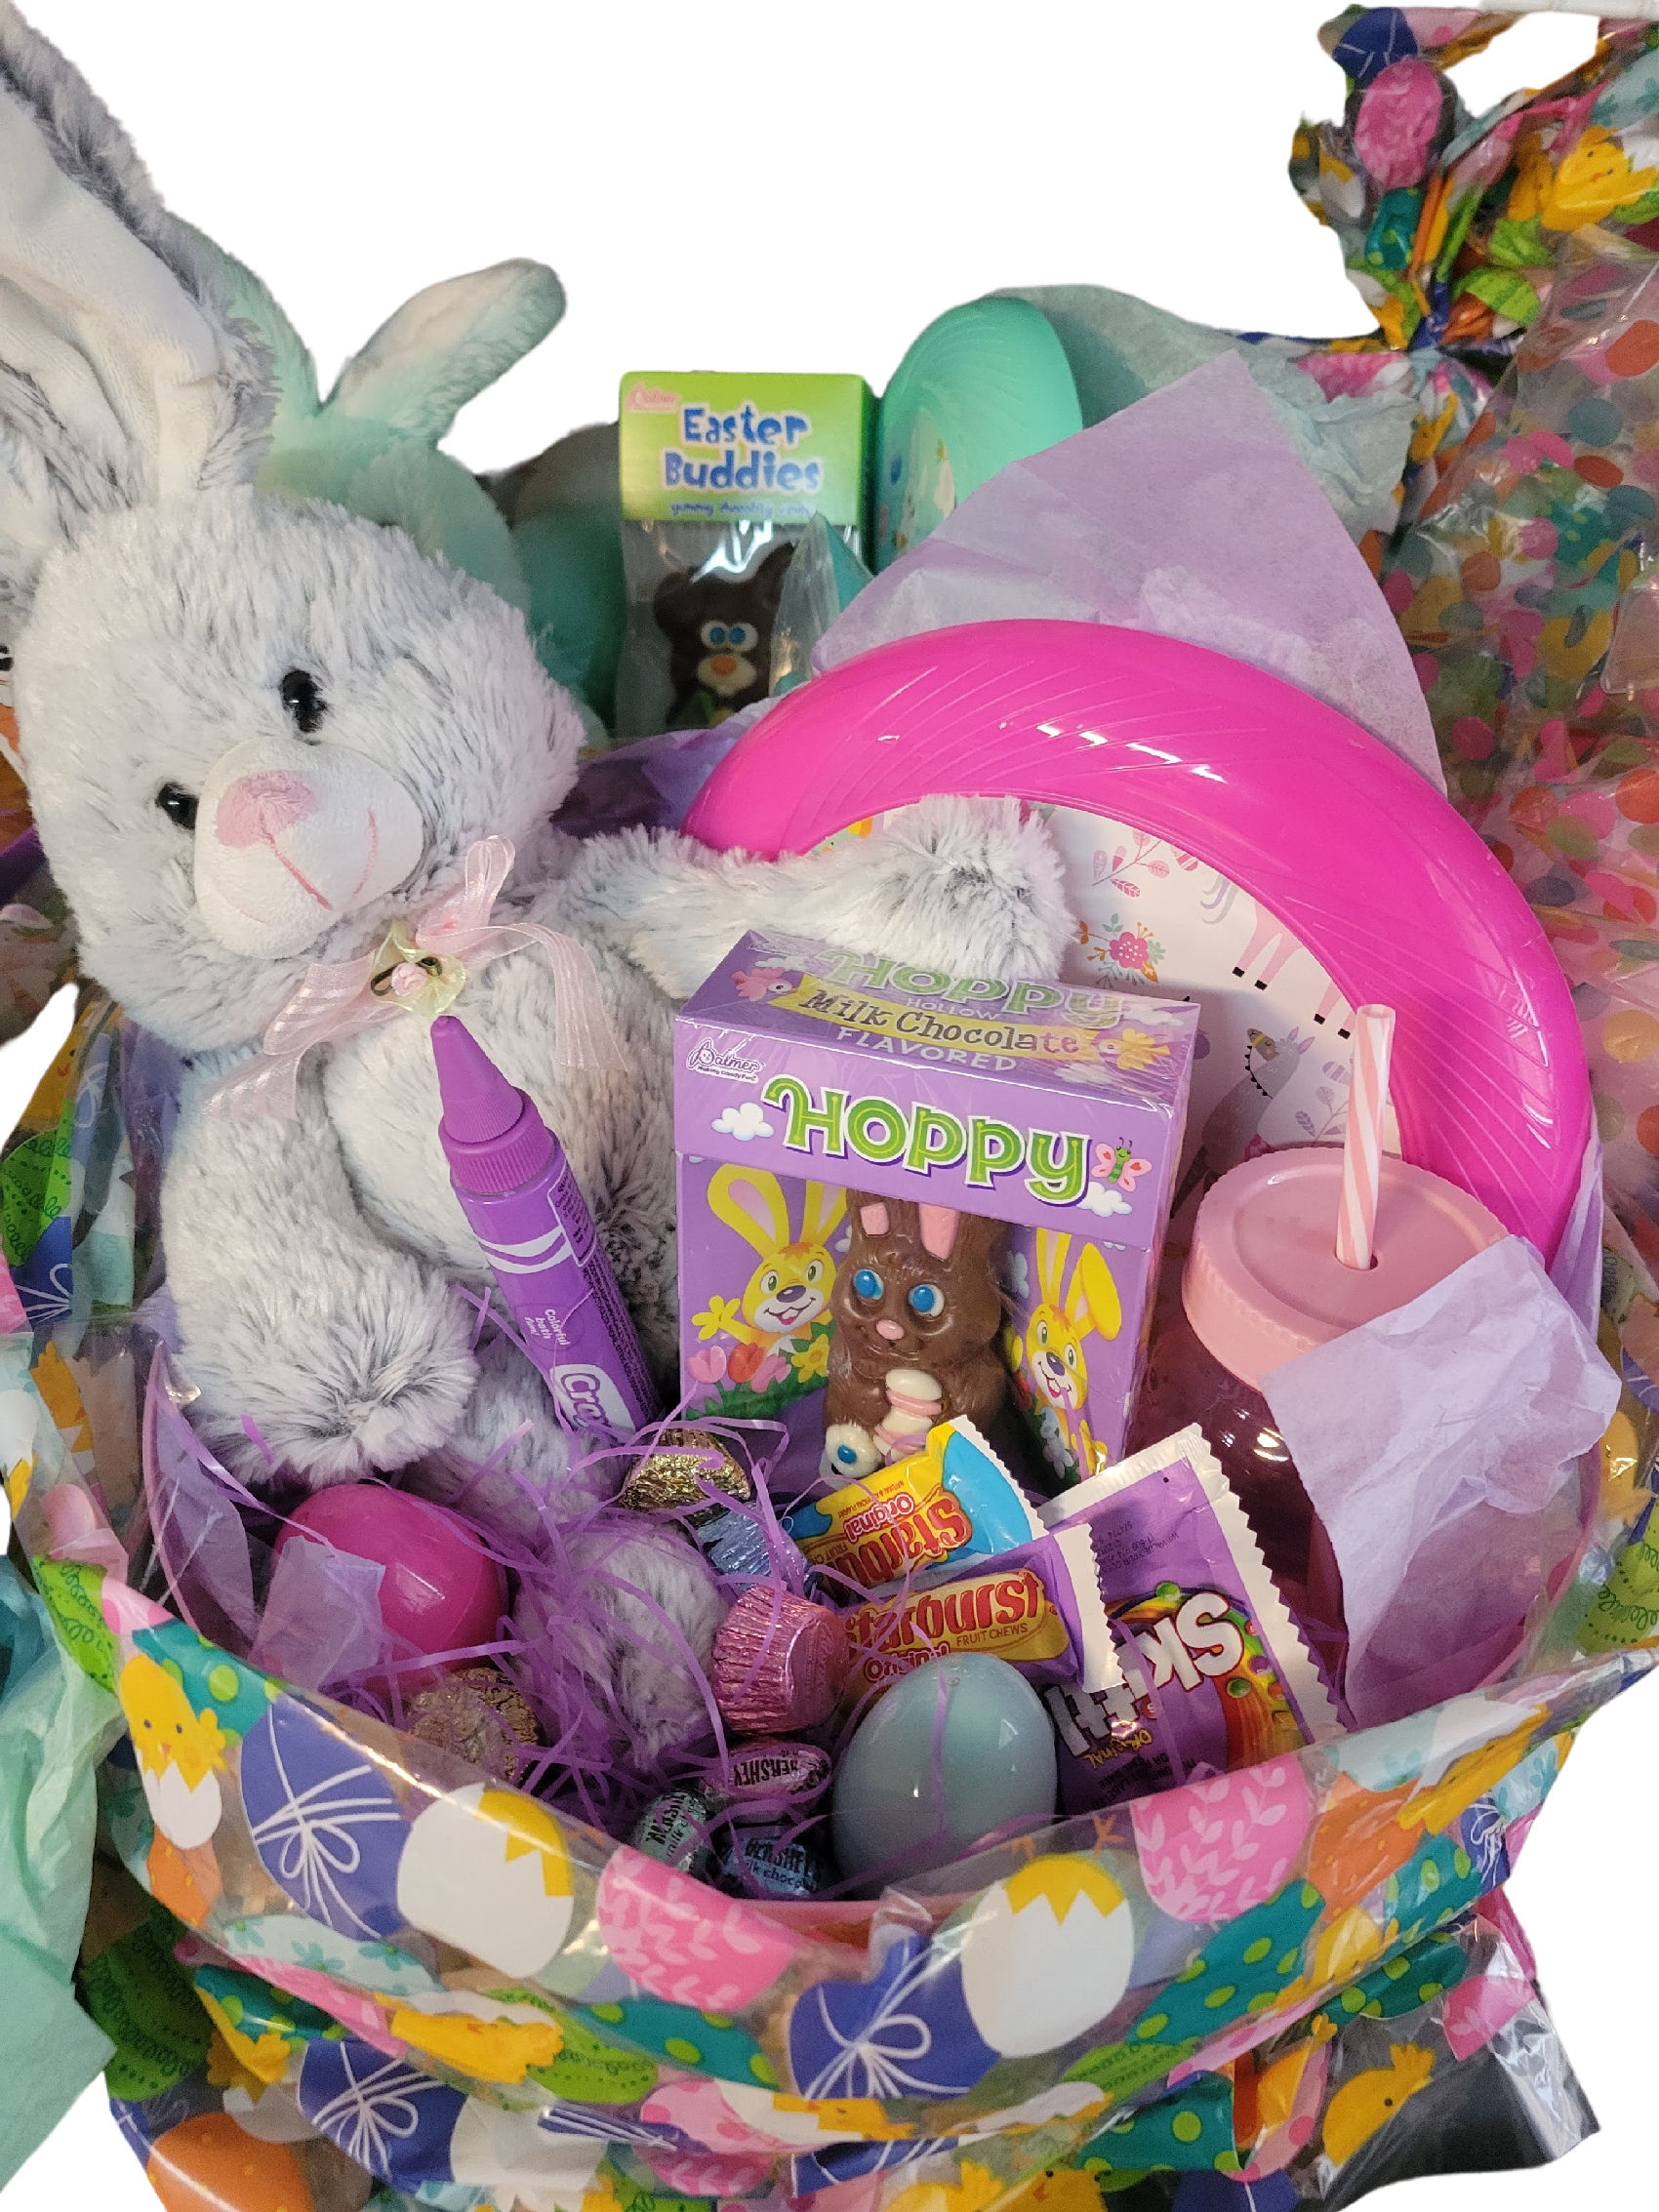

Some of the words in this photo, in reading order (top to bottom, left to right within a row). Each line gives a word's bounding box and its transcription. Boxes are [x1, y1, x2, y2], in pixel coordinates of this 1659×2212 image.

[682, 404, 809, 446] Easter
[664, 449, 821, 491] Buddies
[798, 988, 894, 1026] Milk
[896, 1010, 1079, 1054] Chocolate
[836, 1026, 1017, 1072] FLAVORED
[955, 1631, 988, 1647] FRUIT
[989, 1623, 1029, 1639] CHEWS
